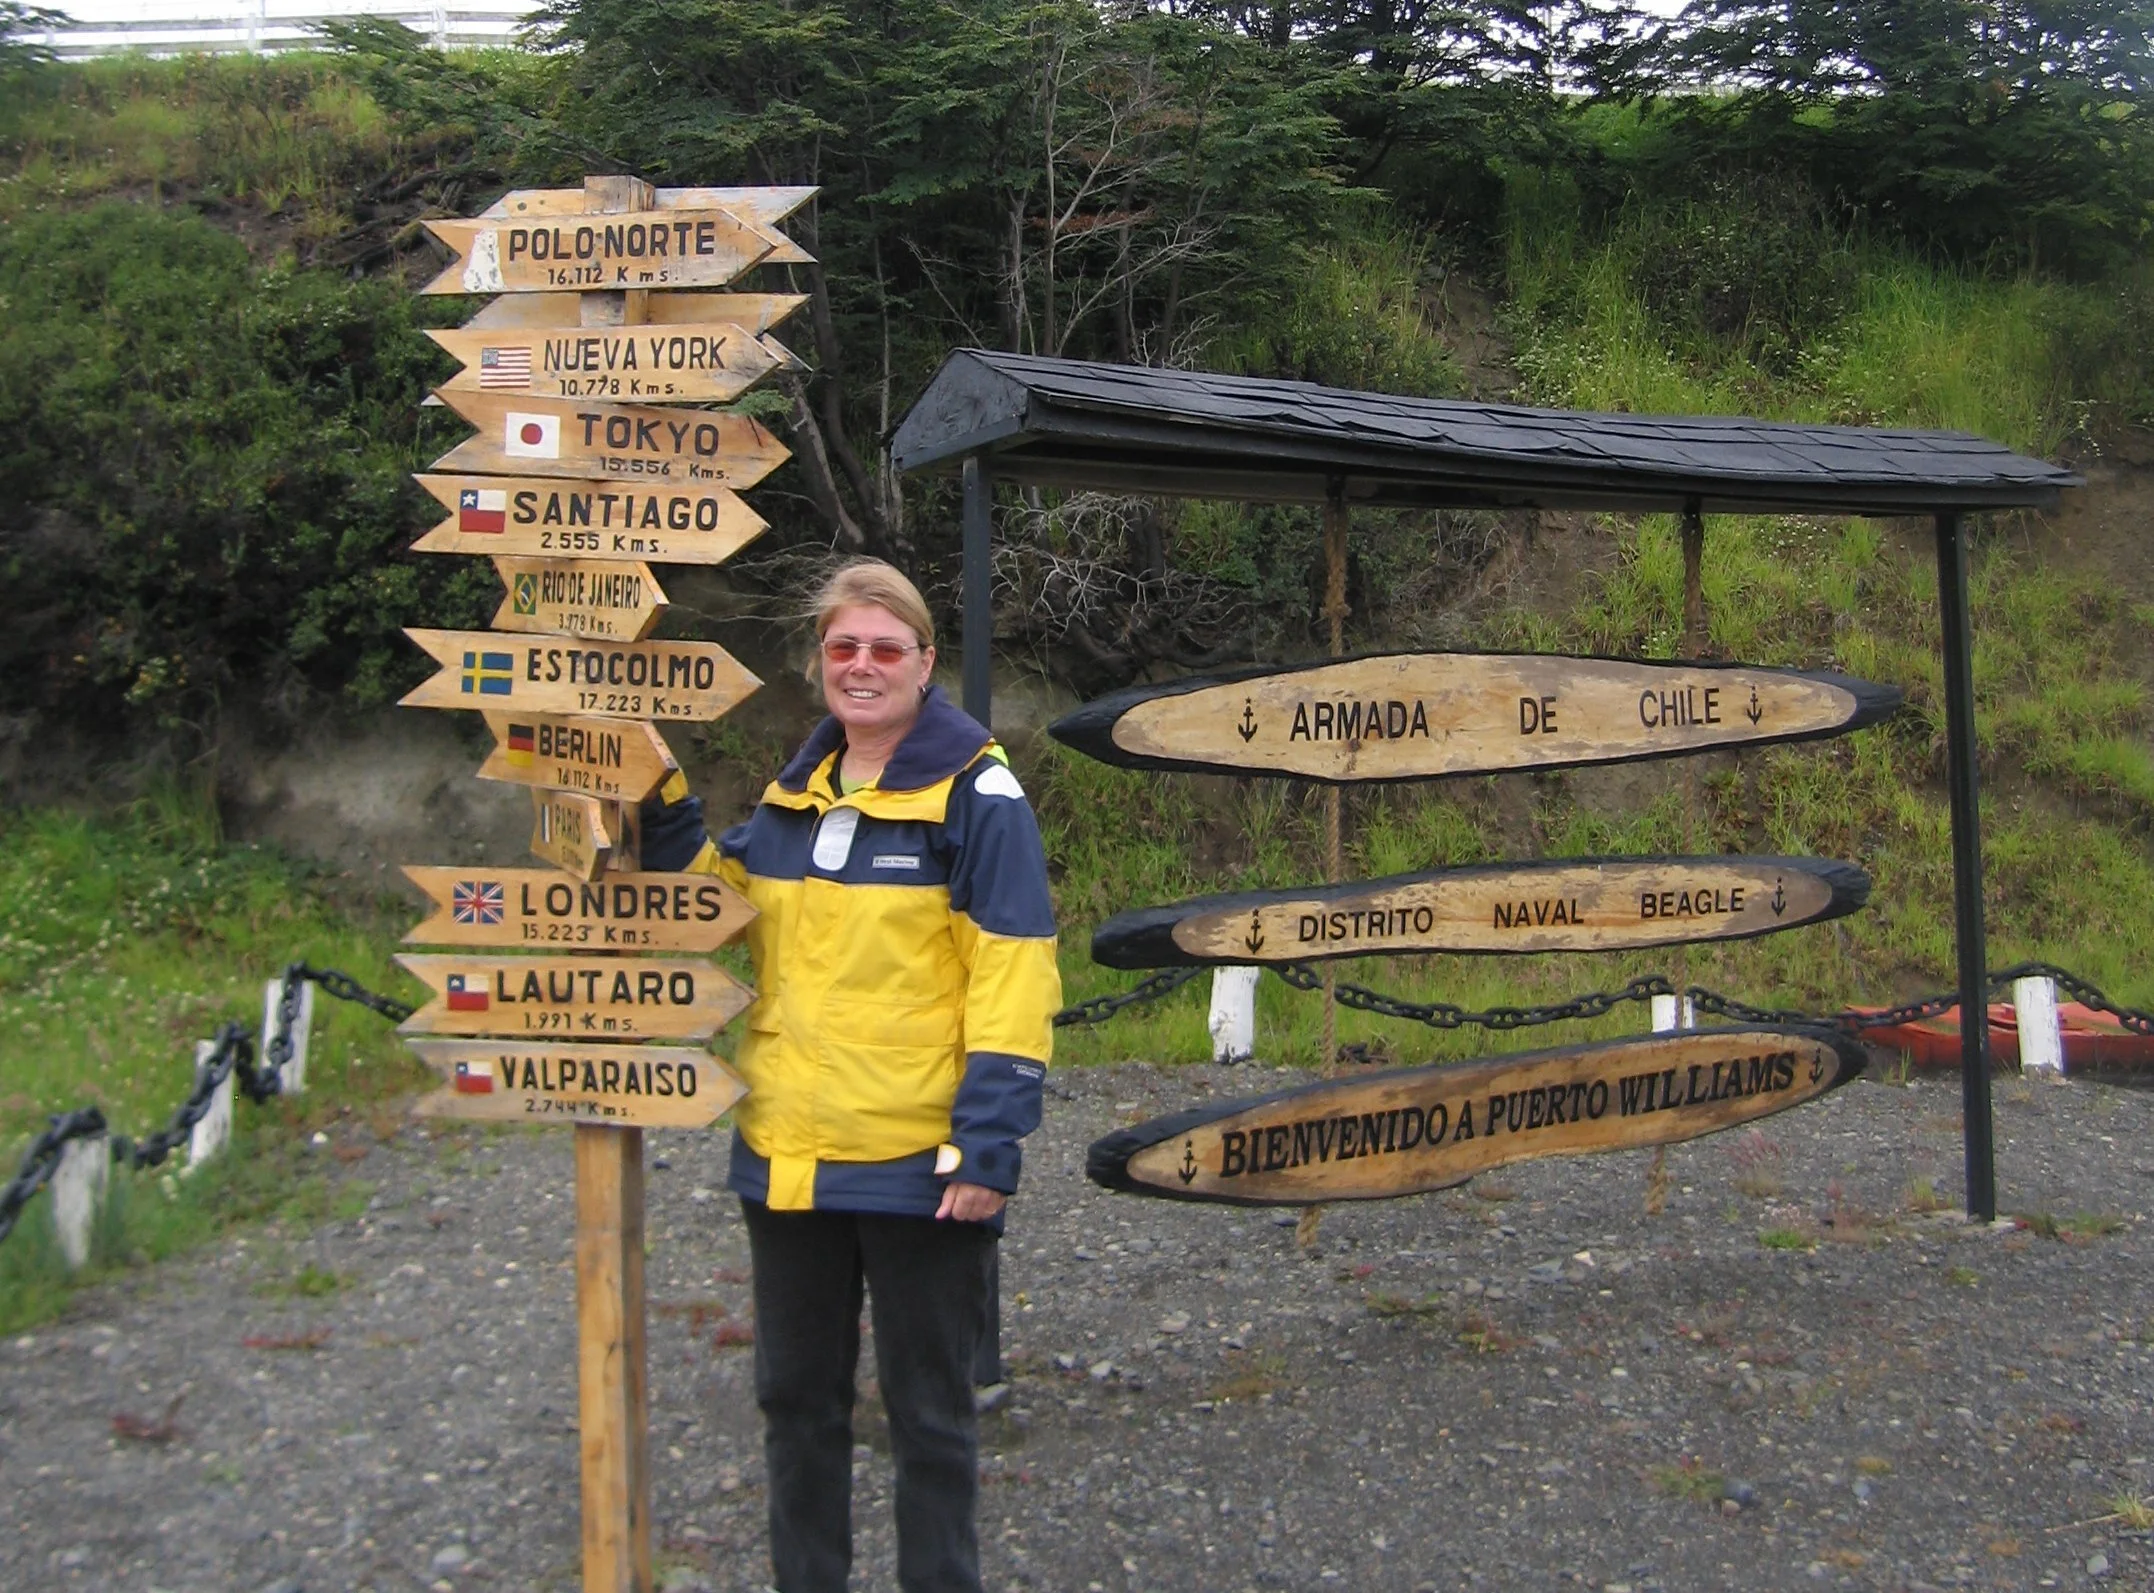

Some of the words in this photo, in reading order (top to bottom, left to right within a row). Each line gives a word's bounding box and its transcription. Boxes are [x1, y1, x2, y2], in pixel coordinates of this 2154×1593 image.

[509, 226, 594, 261] POLO
[604, 222, 715, 258] NORTE
[548, 267, 602, 285] 16.112
[544, 337, 636, 372] NUEVA
[649, 336, 727, 369] YORK
[559, 379, 619, 396] 10.778
[577, 412, 719, 456] TOKYO
[600, 456, 670, 476] 15.556
[689, 463, 730, 480] Kms.
[513, 491, 719, 531] SANTIAGO
[540, 531, 600, 550] 2.555
[613, 535, 667, 554] Kms.
[542, 570, 565, 603] RIO
[569, 572, 584, 605] DE
[589, 573, 641, 609] JANEIRO
[559, 613, 586, 631] 3.778
[527, 648, 714, 689] ESTOCOLMO
[578, 692, 641, 713] 17.223
[653, 697, 702, 716] Kms.
[1289, 700, 1429, 742] ARMADA
[1519, 696, 1558, 734] DE
[1639, 688, 1721, 728] CHILE
[539, 724, 621, 768] BERLIN
[521, 882, 721, 921] LONDRES
[1299, 906, 1433, 942] DISTRITO
[1494, 899, 1584, 929] NAVAL
[1640, 888, 1745, 919] BEAGLE
[522, 922, 591, 942] 15.223
[497, 969, 694, 1005] LAUTARO
[524, 1012, 571, 1029] 1.991
[500, 1055, 697, 1097] VALPARAISO
[526, 1100, 576, 1114] 2.744
[1219, 1102, 1448, 1179] BIENVENIDO
[1451, 1104, 1474, 1141] A
[1484, 1079, 1608, 1137] PUERTO
[1617, 1050, 1795, 1116] WILLIAMS
